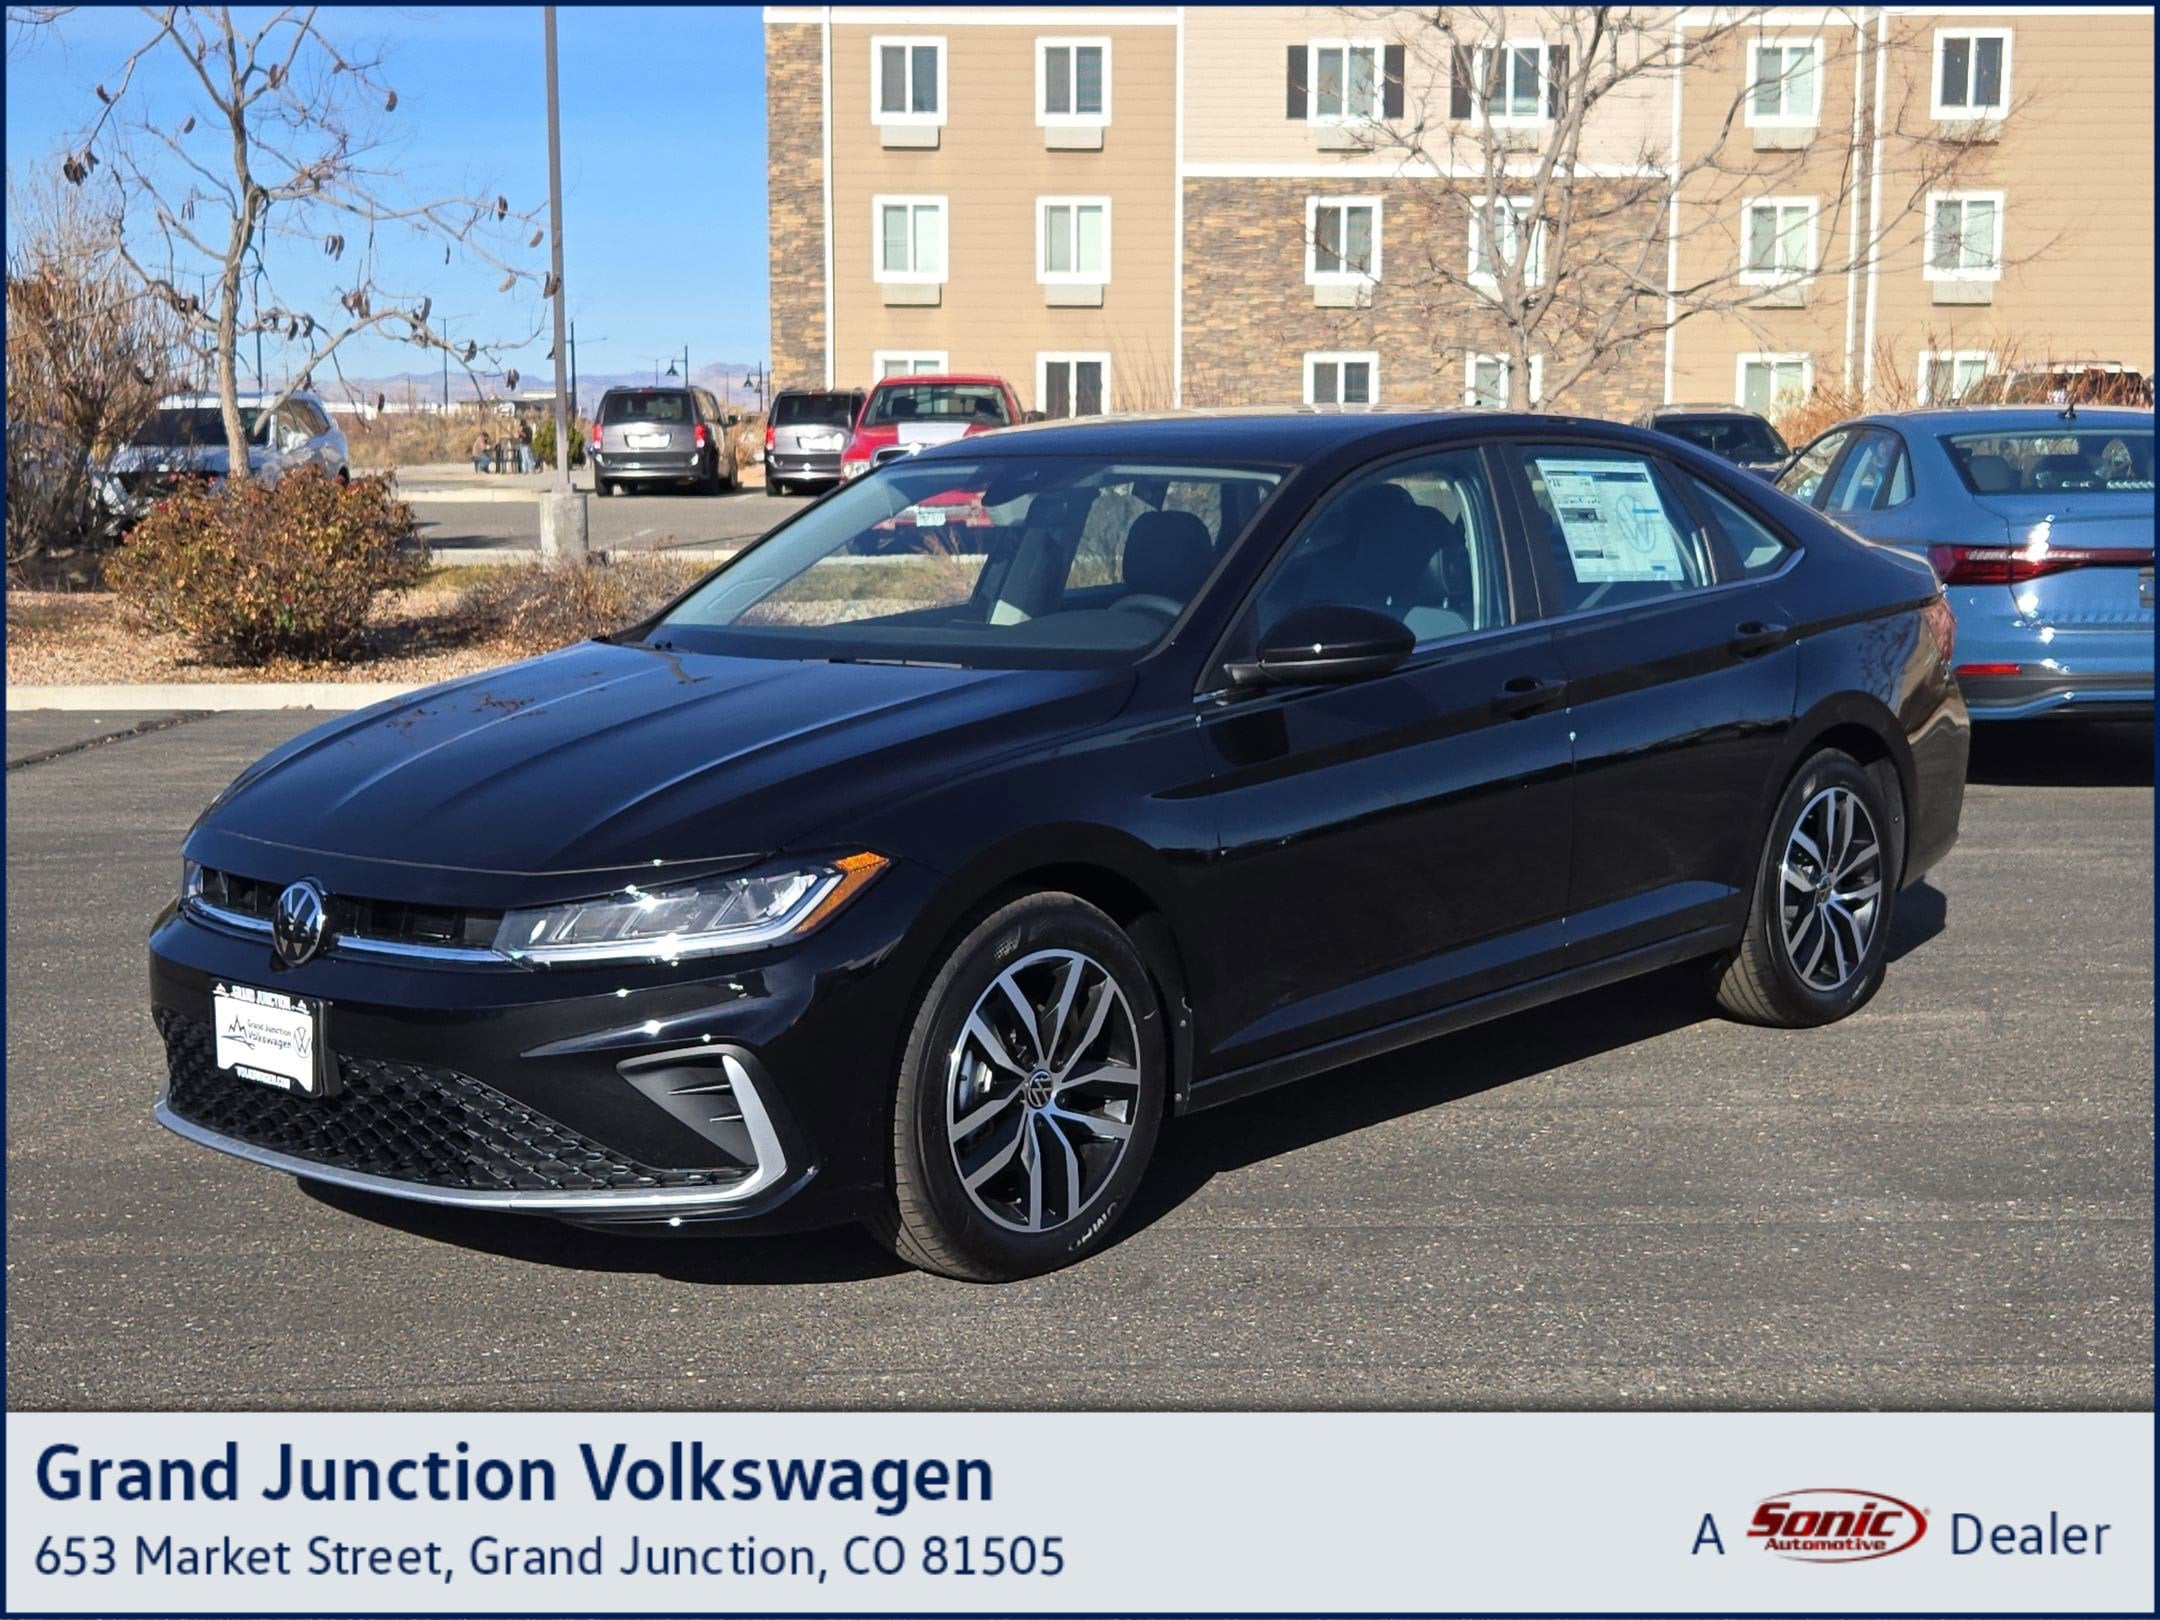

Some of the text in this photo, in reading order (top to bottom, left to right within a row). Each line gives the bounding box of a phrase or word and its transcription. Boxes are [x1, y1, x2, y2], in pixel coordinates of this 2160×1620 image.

[247, 1018, 292, 1037] Grand Junction
[247, 1031, 292, 1050] Volkswagen
